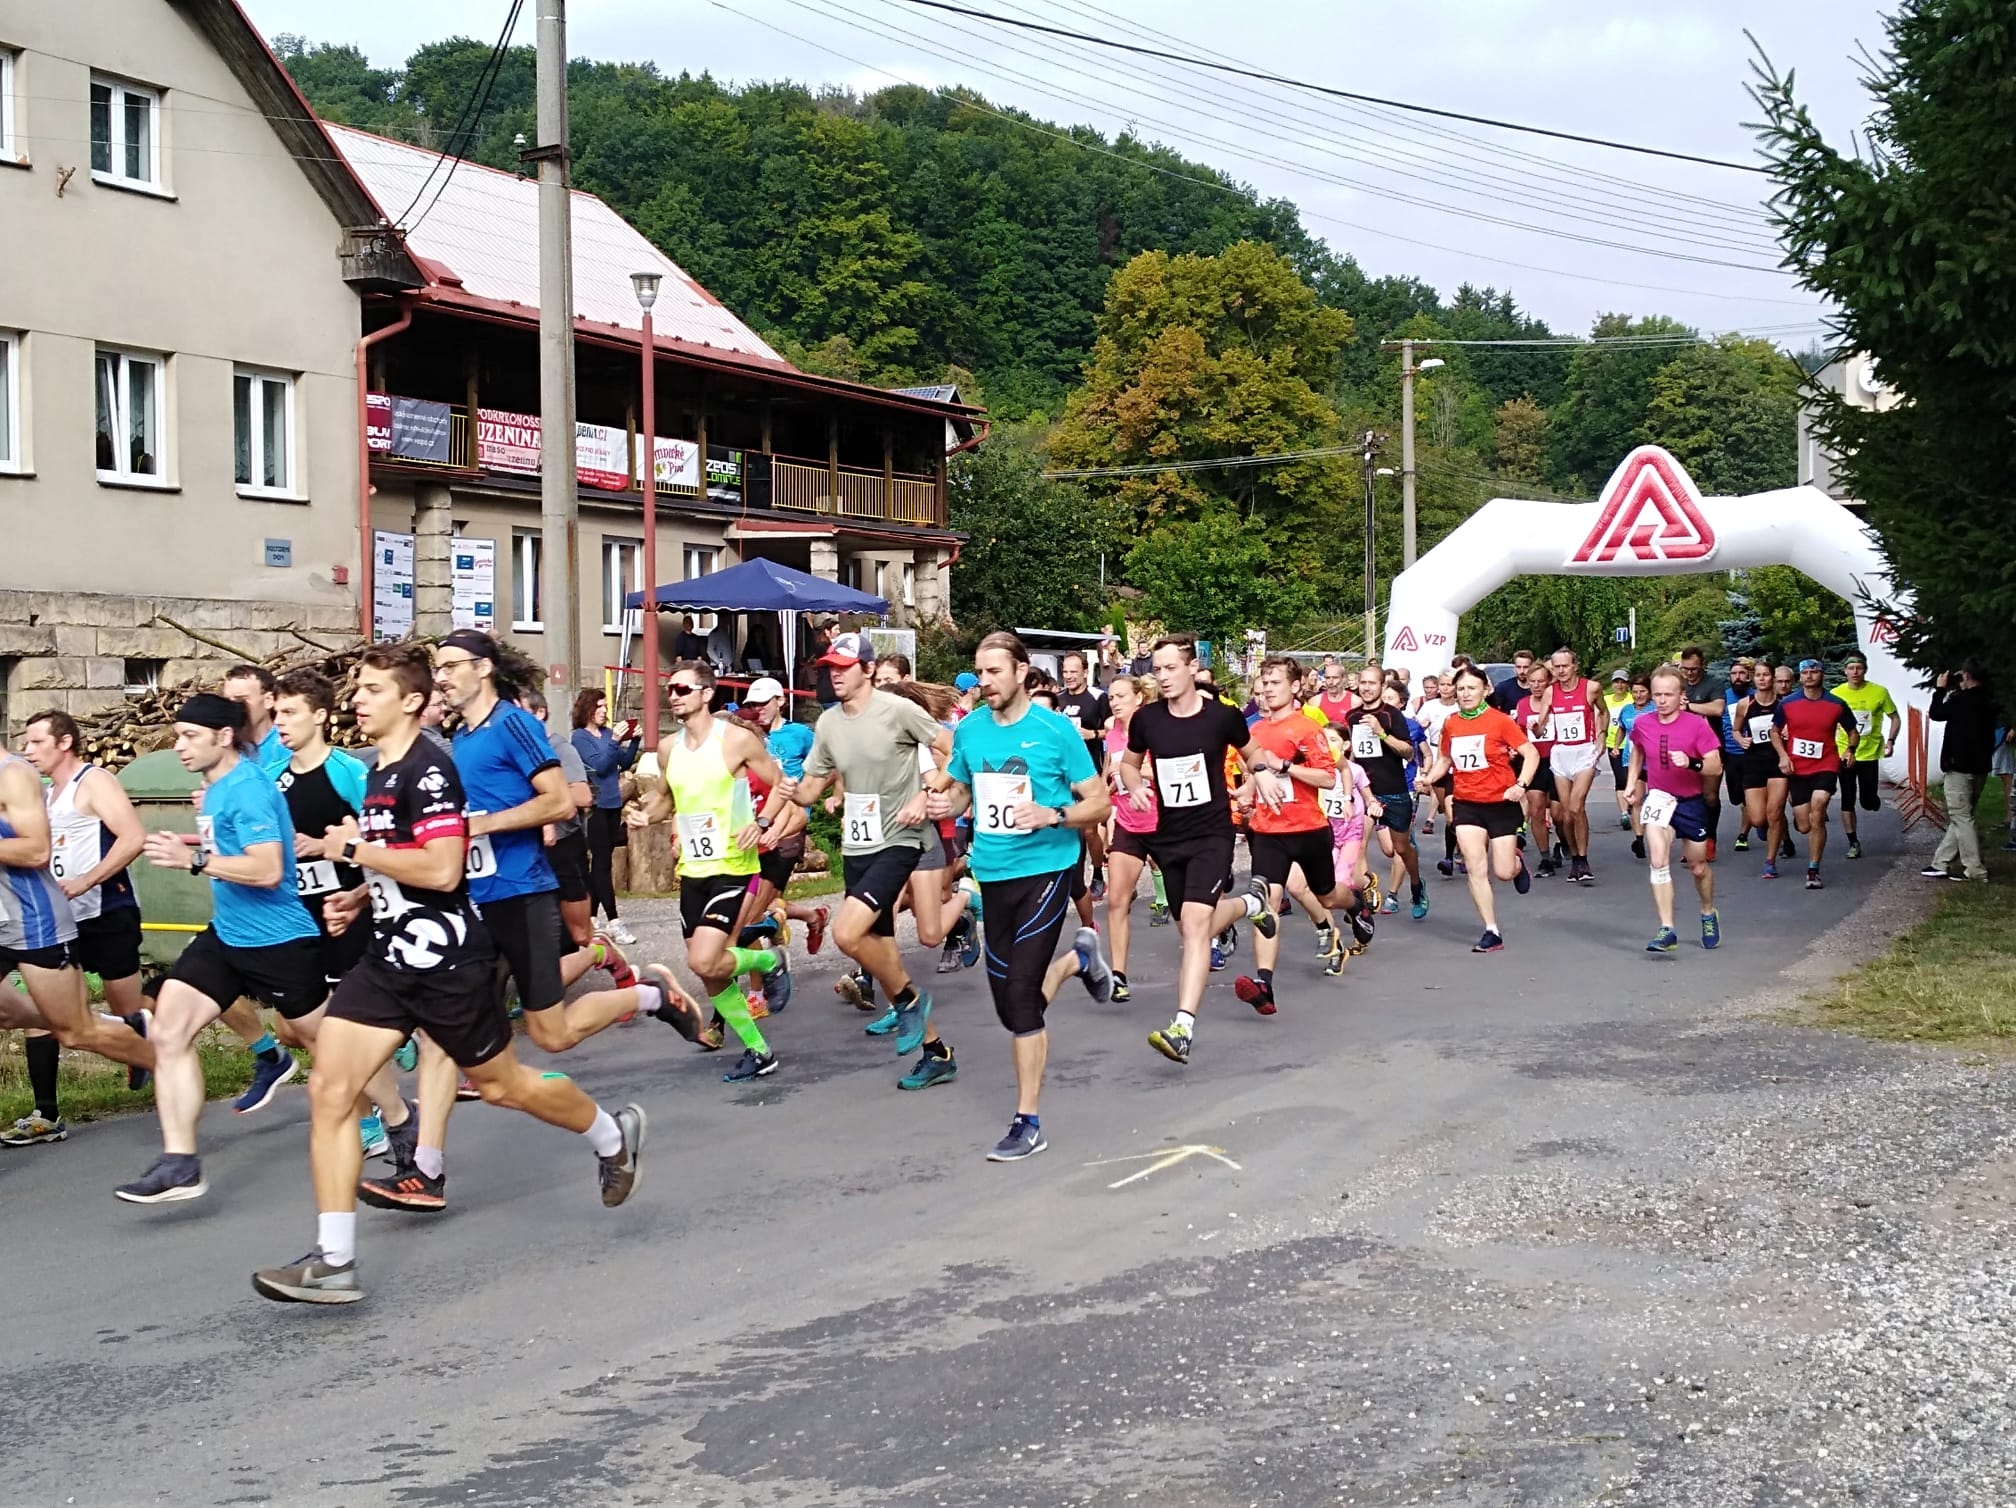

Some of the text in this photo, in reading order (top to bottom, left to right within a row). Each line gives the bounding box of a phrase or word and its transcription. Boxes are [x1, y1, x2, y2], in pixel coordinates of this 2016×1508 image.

[1424, 633, 1447, 646] VZP
[1563, 727, 1579, 739] 19
[1358, 740, 1374, 755] 43
[1799, 741, 1816, 756] 33
[1459, 753, 1480, 769] 72
[1170, 782, 1199, 804] 71
[1325, 799, 1343, 815] 73
[1642, 805, 1662, 822] 84
[851, 820, 872, 841] 81
[690, 837, 714, 858] 18
